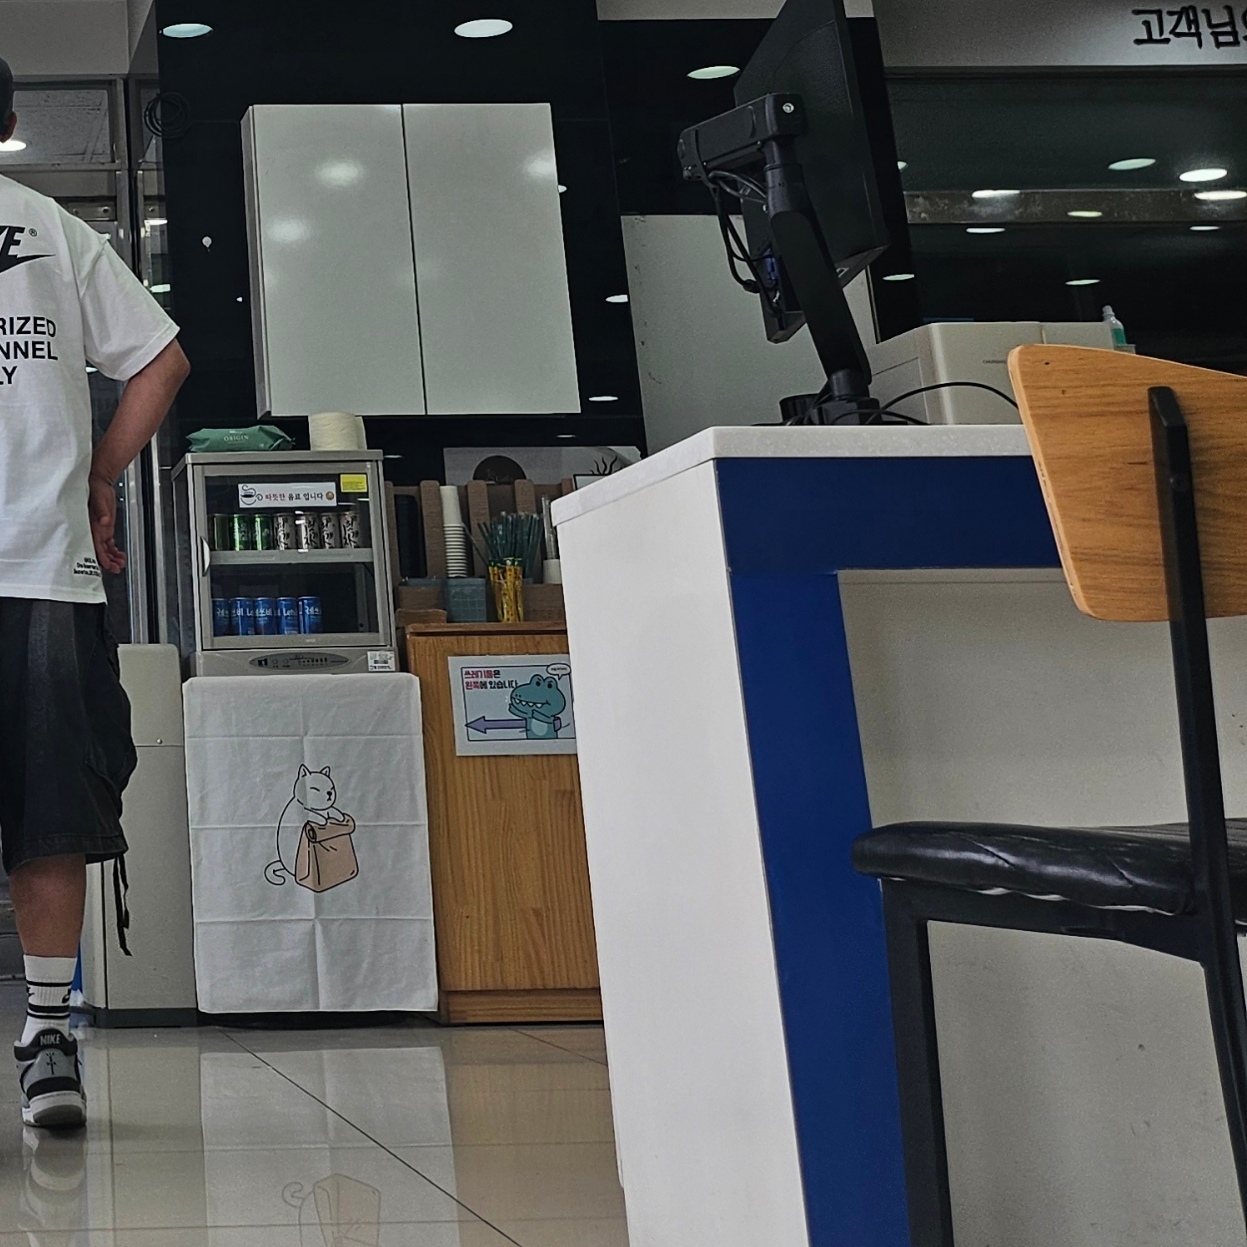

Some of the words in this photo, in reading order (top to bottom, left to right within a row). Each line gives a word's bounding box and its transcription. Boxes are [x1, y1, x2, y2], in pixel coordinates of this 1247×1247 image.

[223, 434, 249, 442] ORIGIN
[265, 492, 286, 501] 따뜻한
[288, 492, 301, 501] 음료
[303, 491, 324, 501] 입니다
[40, 1032, 61, 1046] NIKE
